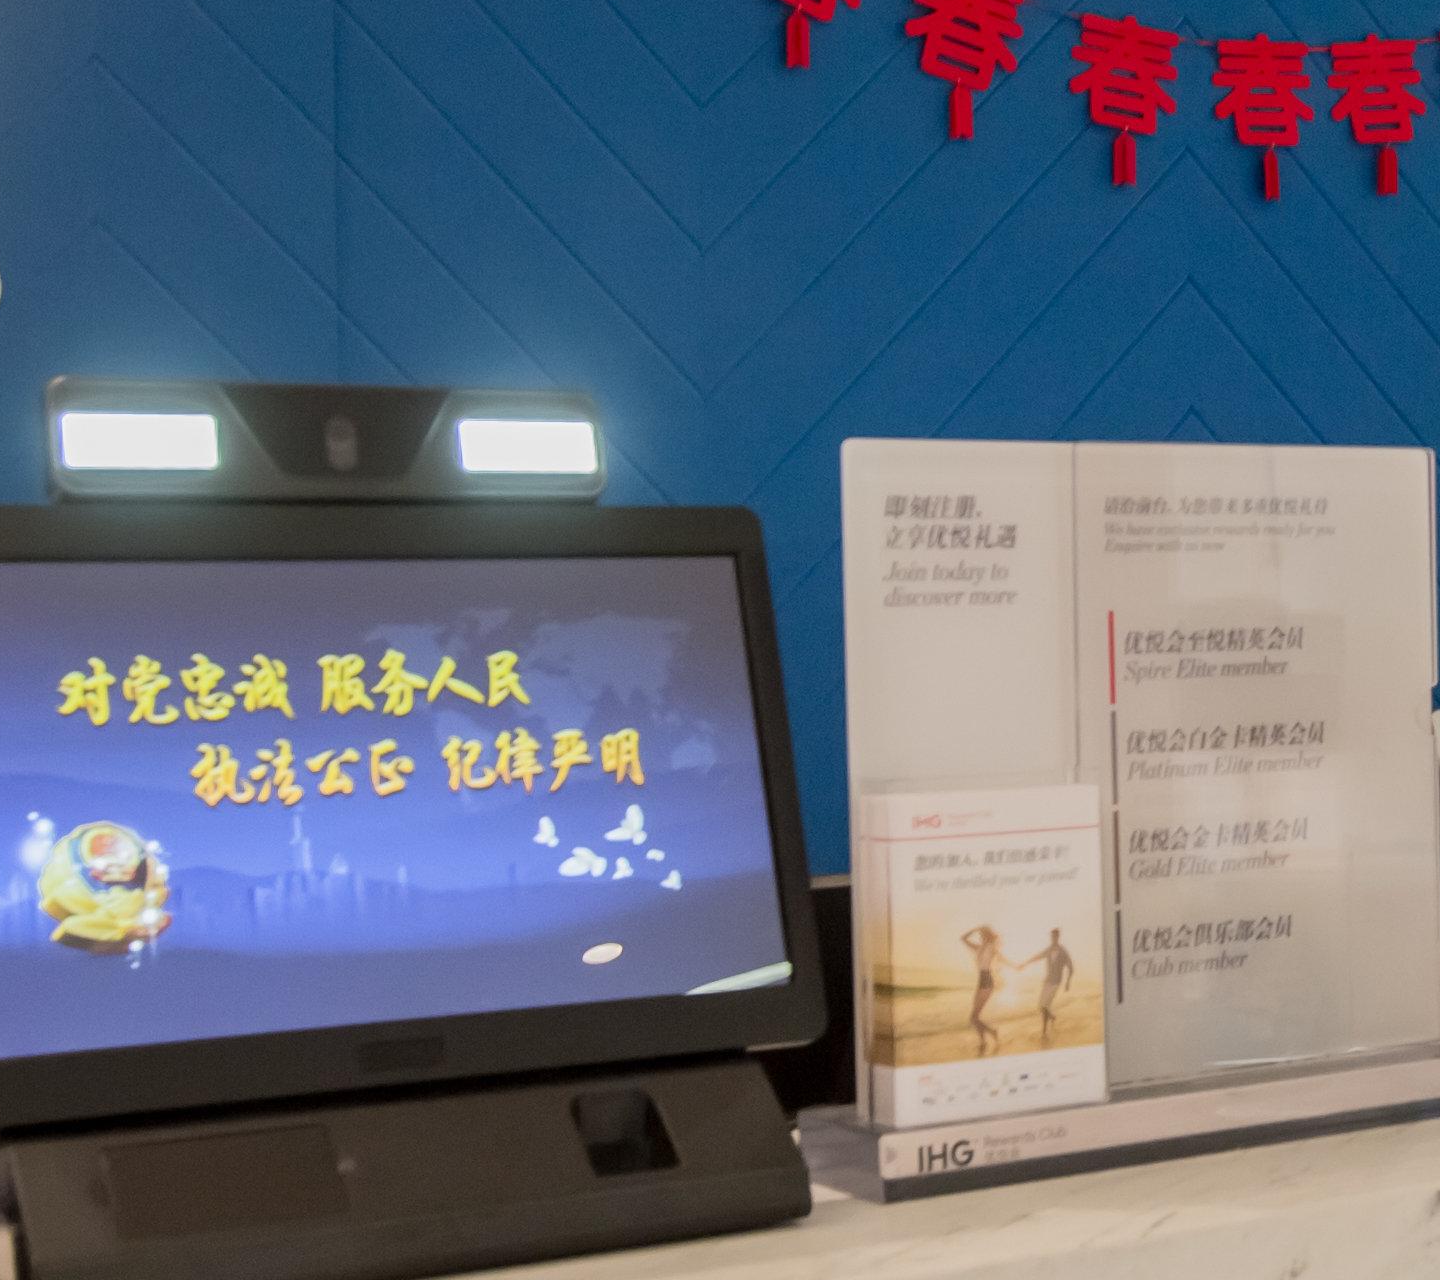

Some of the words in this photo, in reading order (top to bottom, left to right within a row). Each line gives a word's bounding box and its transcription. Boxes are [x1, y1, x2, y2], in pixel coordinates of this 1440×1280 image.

[1069, 12, 1180, 135] 春
[1212, 34, 1313, 146] 春
[1327, 35, 1425, 144] 春
[881, 560, 928, 582] Join
[932, 559, 986, 586] today
[990, 563, 1010, 581] to
[882, 586, 964, 608] discover
[968, 590, 1019, 606] more
[1123, 660, 1173, 686] Spire
[1176, 657, 1218, 680] Elite
[1220, 655, 1289, 677] member
[56, 652, 297, 726] 对党忠诚
[317, 648, 533, 717] 服务人民
[191, 736, 416, 808] 执法公正
[441, 725, 646, 794] 纪律严明
[1126, 757, 1209, 782] Platinum
[1213, 756, 1256, 777] Elite
[1257, 751, 1324, 773] member
[1128, 856, 1173, 881] Gold
[1176, 853, 1215, 876] Elite
[1220, 850, 1291, 873] member
[1131, 954, 1174, 980] Club
[1177, 950, 1249, 974] member
[917, 1138, 975, 1172] IHG
